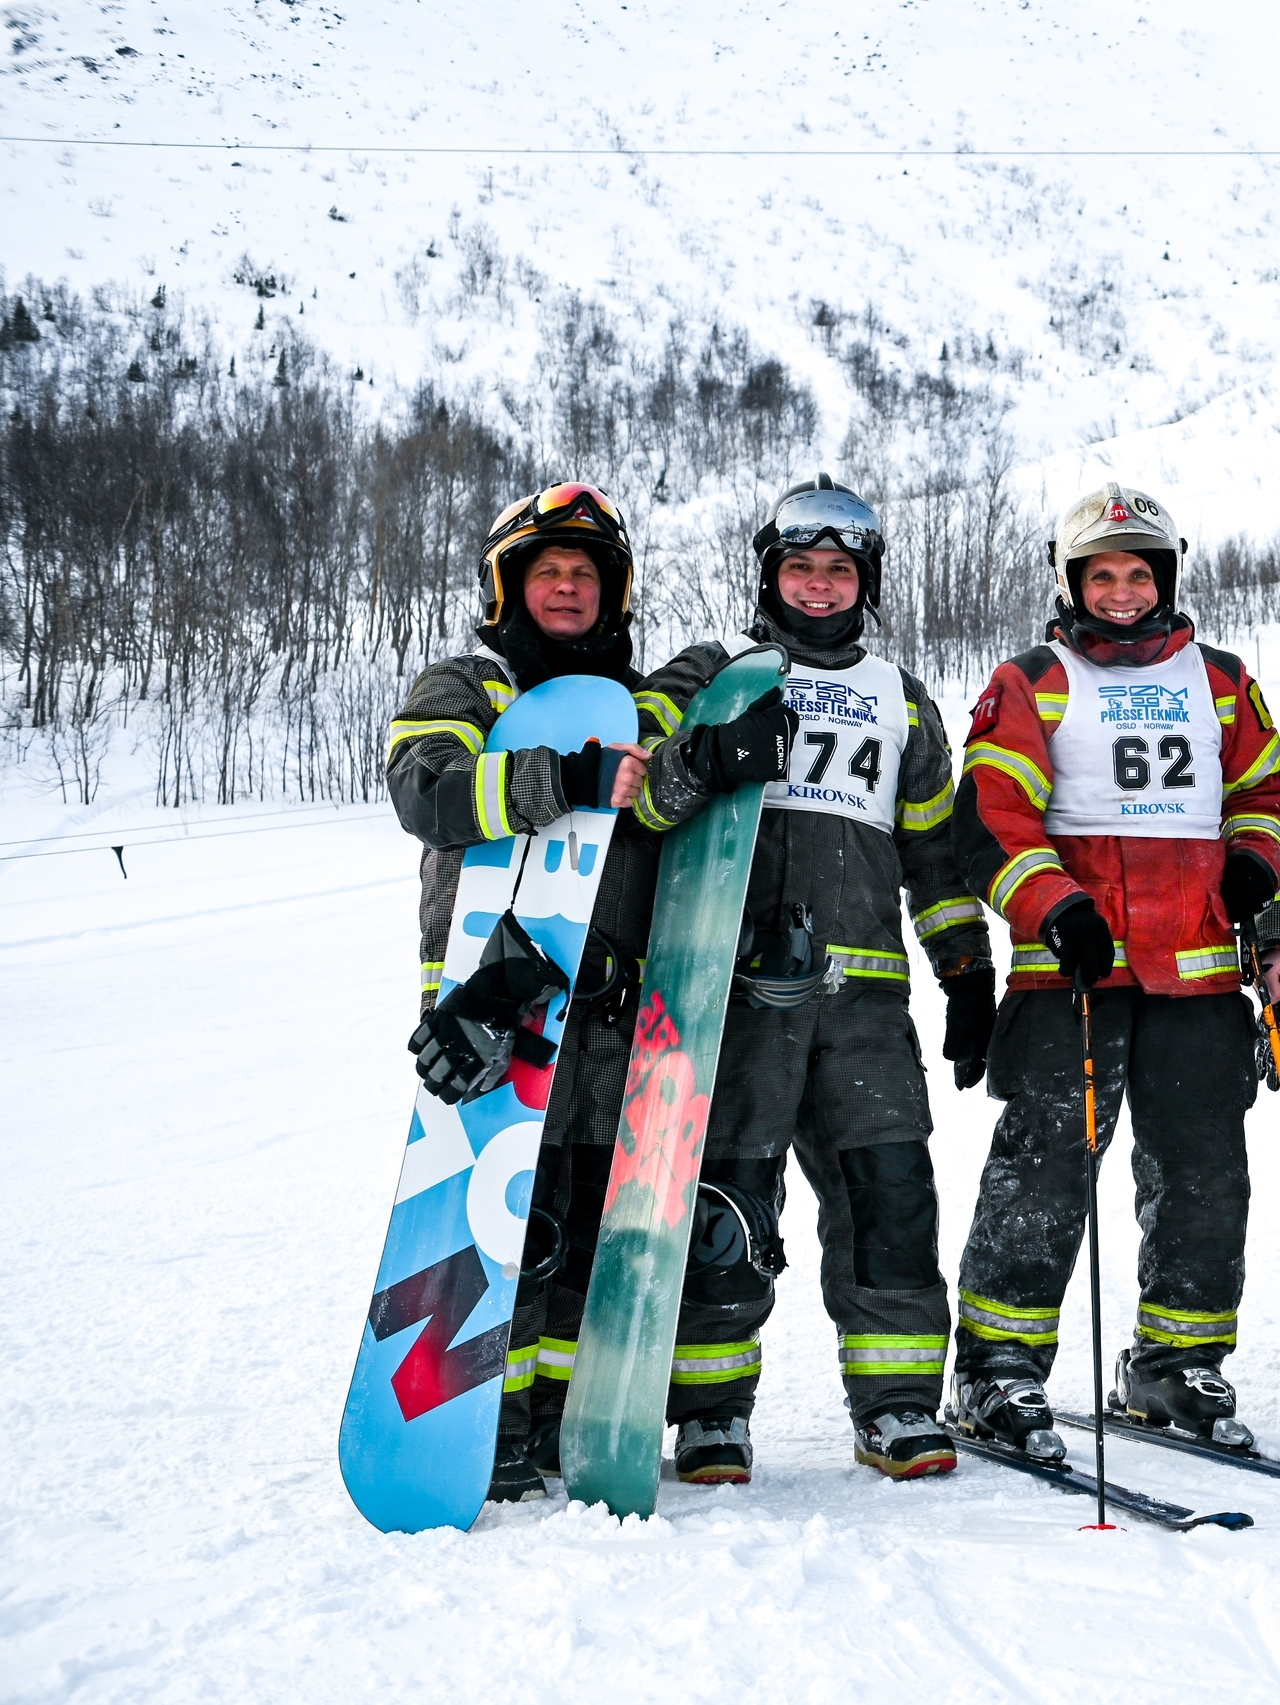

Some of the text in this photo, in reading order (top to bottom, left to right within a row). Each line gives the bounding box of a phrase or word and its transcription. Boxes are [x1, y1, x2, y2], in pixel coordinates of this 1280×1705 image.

[1134, 497, 1159, 517] 06
[799, 713, 863, 728] OSLO NORWAY
[1101, 705, 1190, 723] PRESSETEKNIKK
[1144, 723, 1175, 731] NORWAY
[775, 734, 785, 771] AUCRUX
[776, 731, 883, 795] 74
[1111, 734, 1196, 792] 62
[786, 784, 868, 811] KIROVSK
[1120, 802, 1186, 815] KIROVSK
